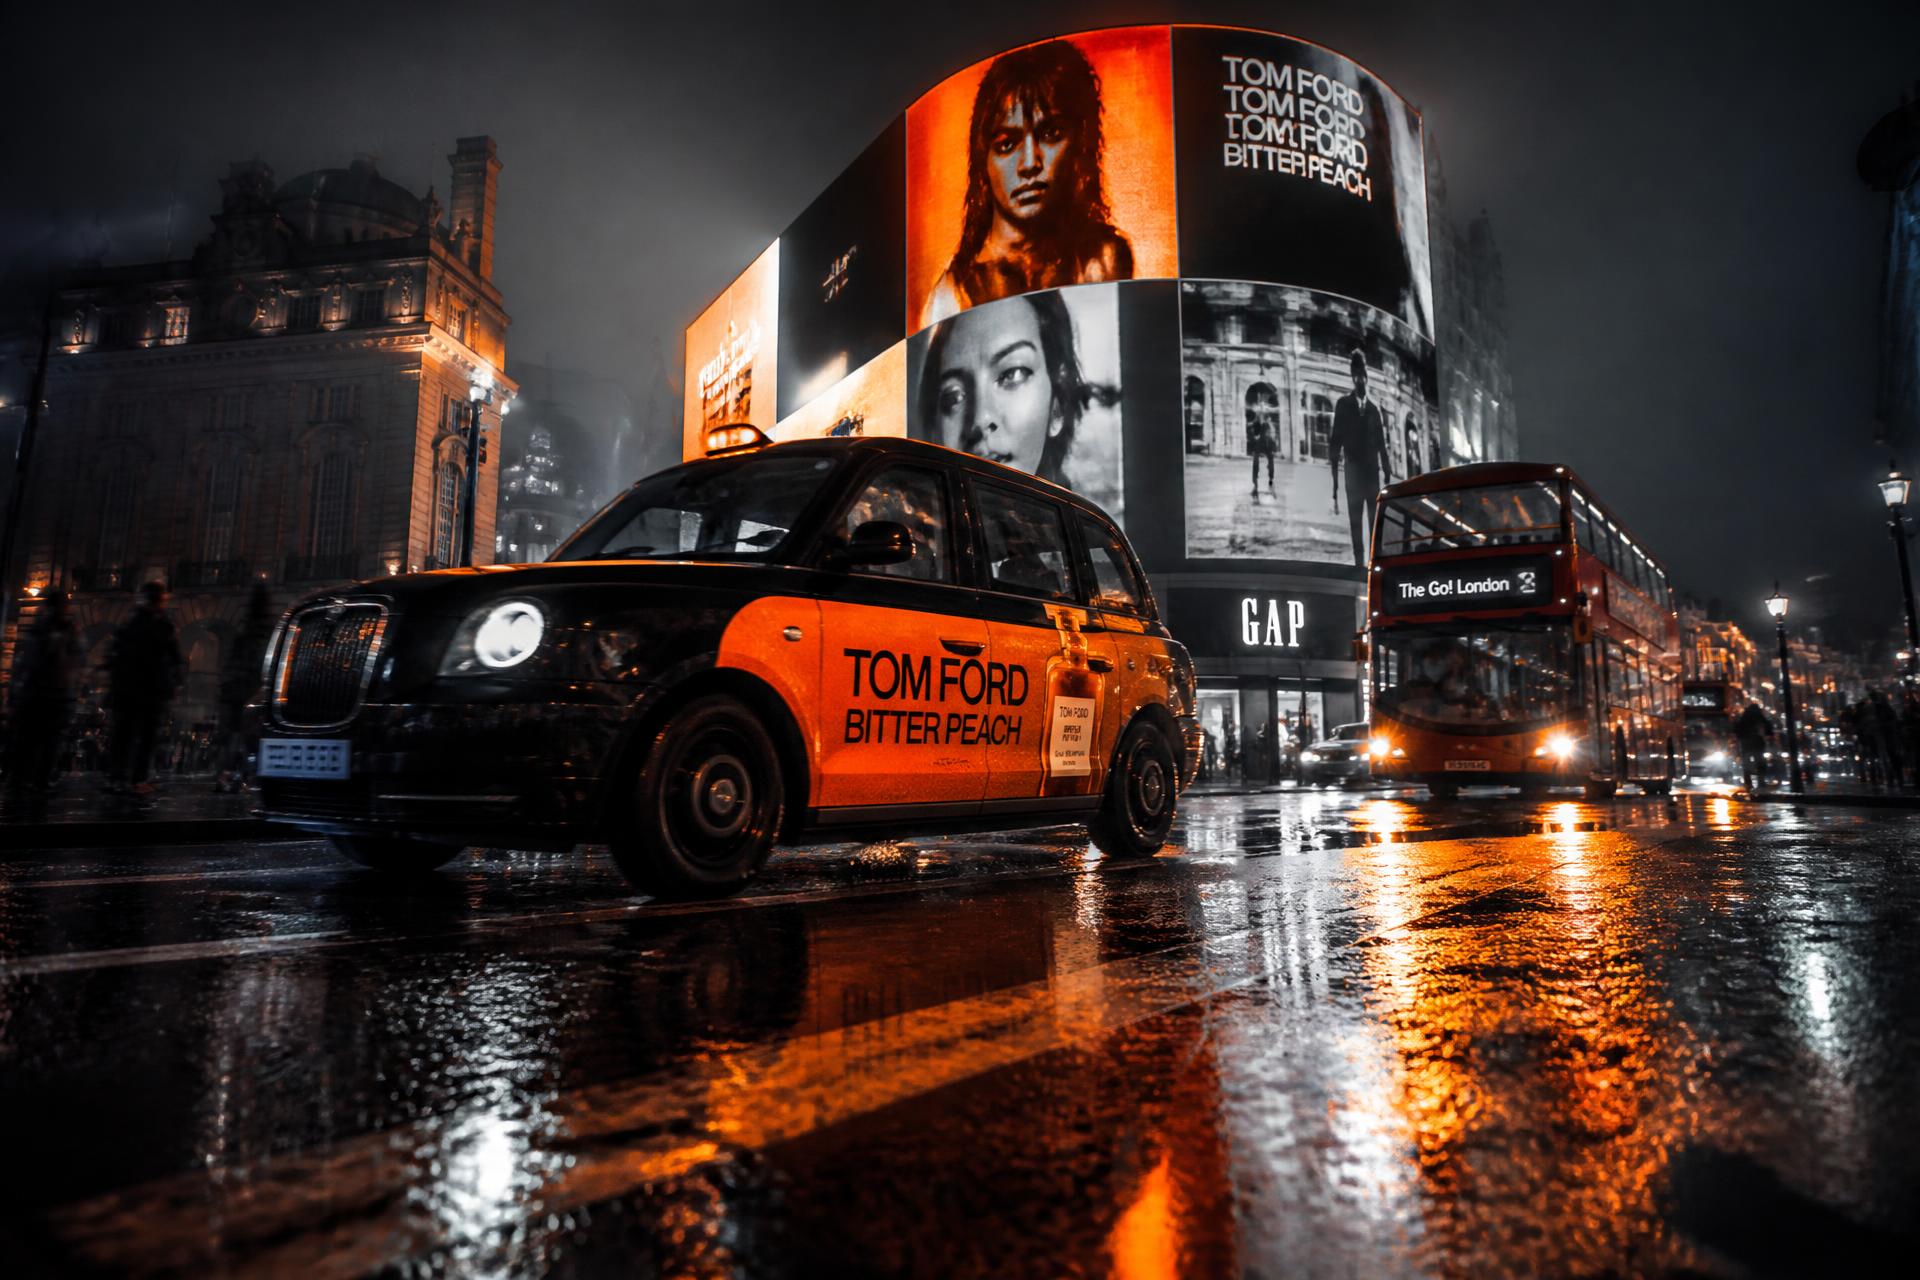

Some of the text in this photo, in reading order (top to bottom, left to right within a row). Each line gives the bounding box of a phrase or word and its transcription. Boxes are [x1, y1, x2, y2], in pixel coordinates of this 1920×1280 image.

[1222, 55, 1364, 117] TOM FORD
[1222, 84, 1366, 140] TOM FORD
[1224, 112, 1368, 172] TOM FORD
[1223, 142, 1372, 203] BITTER PEACH
[1398, 582, 1426, 599] The
[1428, 579, 1453, 597] Go!
[1457, 577, 1510, 595] London
[1241, 597, 1305, 648] GAP
[843, 647, 1030, 707] TOM FORD
[844, 708, 942, 745] BITTER
[944, 712, 1023, 746] PEACH
